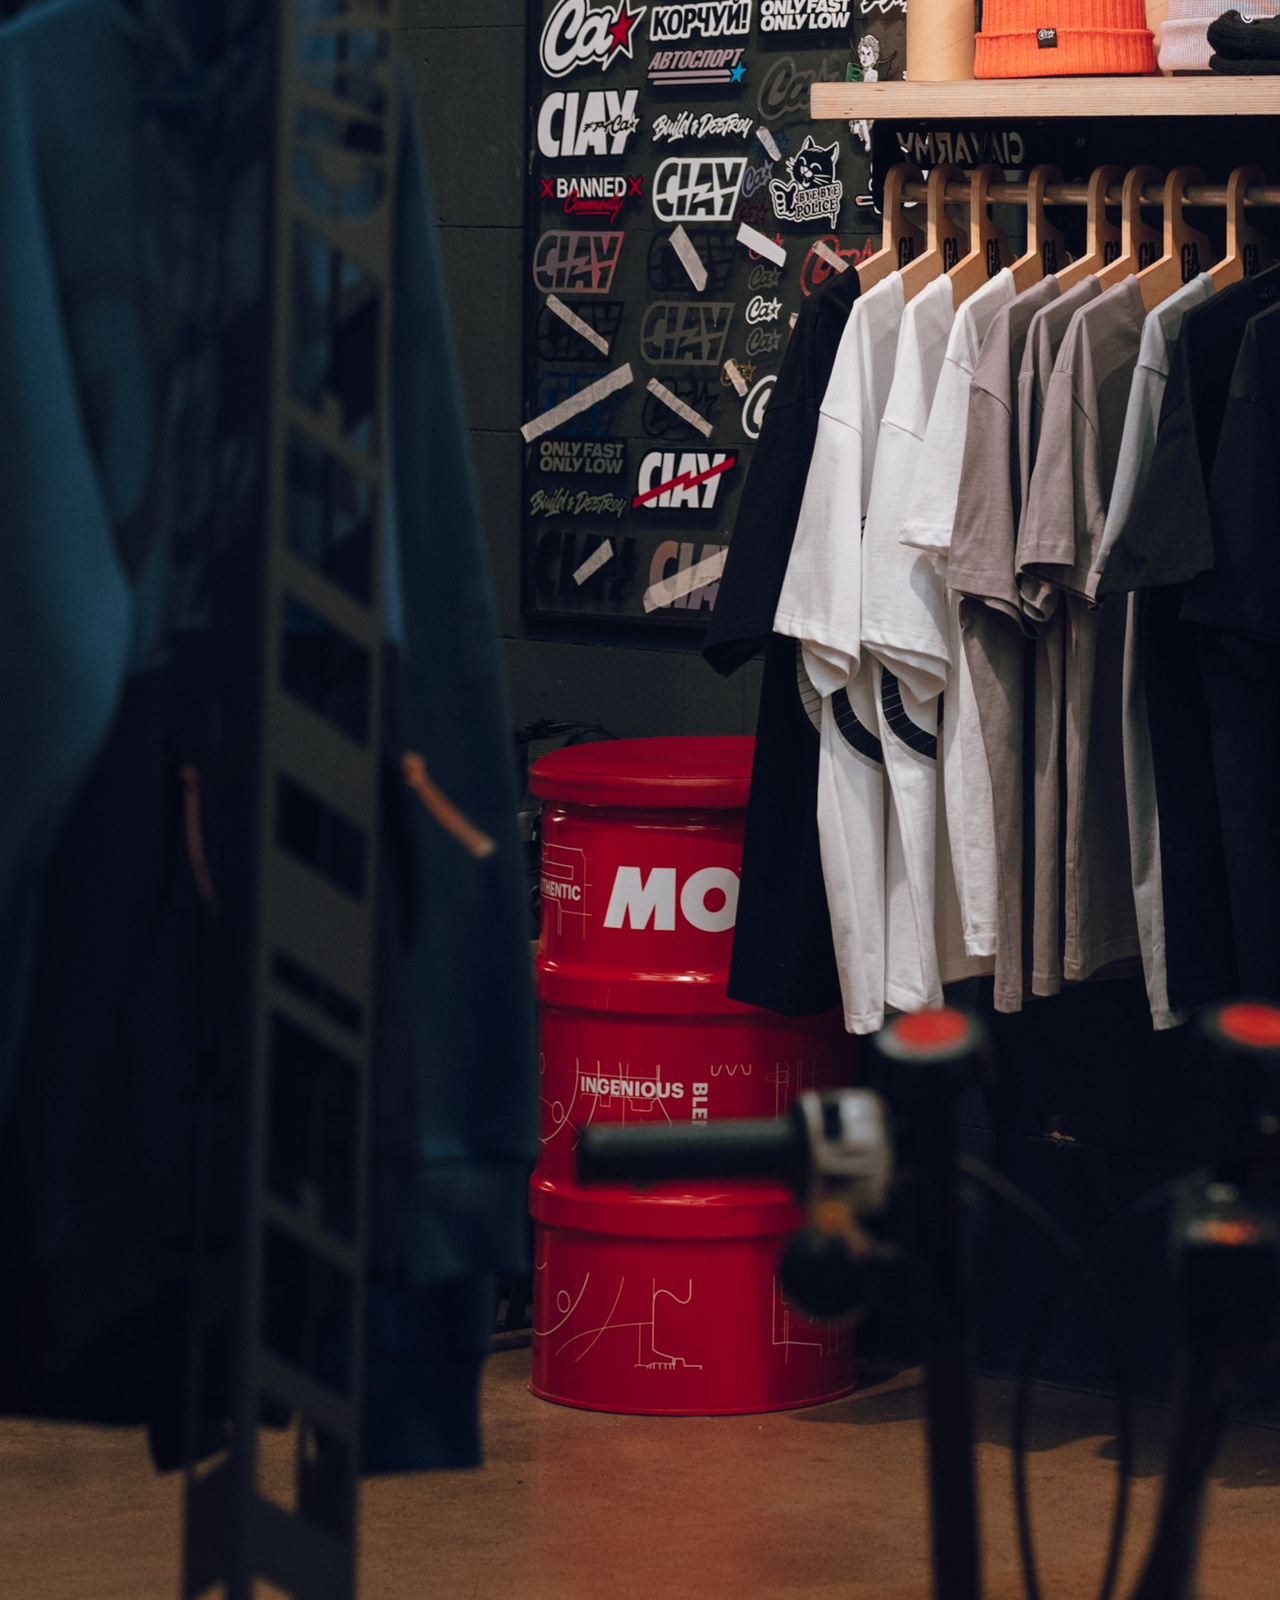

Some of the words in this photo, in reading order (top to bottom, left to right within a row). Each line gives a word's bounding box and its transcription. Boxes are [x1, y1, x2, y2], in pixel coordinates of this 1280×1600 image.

[760, 0, 808, 16] ONLY
[760, 15, 807, 33] ONLY
[807, 12, 851, 30] LOW
[649, 47, 746, 70] АВТОСПОРТ
[556, 176, 628, 199] BANNED
[798, 188, 820, 202] BYE
[820, 184, 841, 200] BYE
[795, 201, 838, 219] POLICE
[540, 441, 583, 456] ONLY
[583, 442, 624, 458] FAST
[540, 456, 584, 473] ONLY
[584, 458, 624, 475] LOW
[580, 1076, 685, 1100] INGENIOUS
